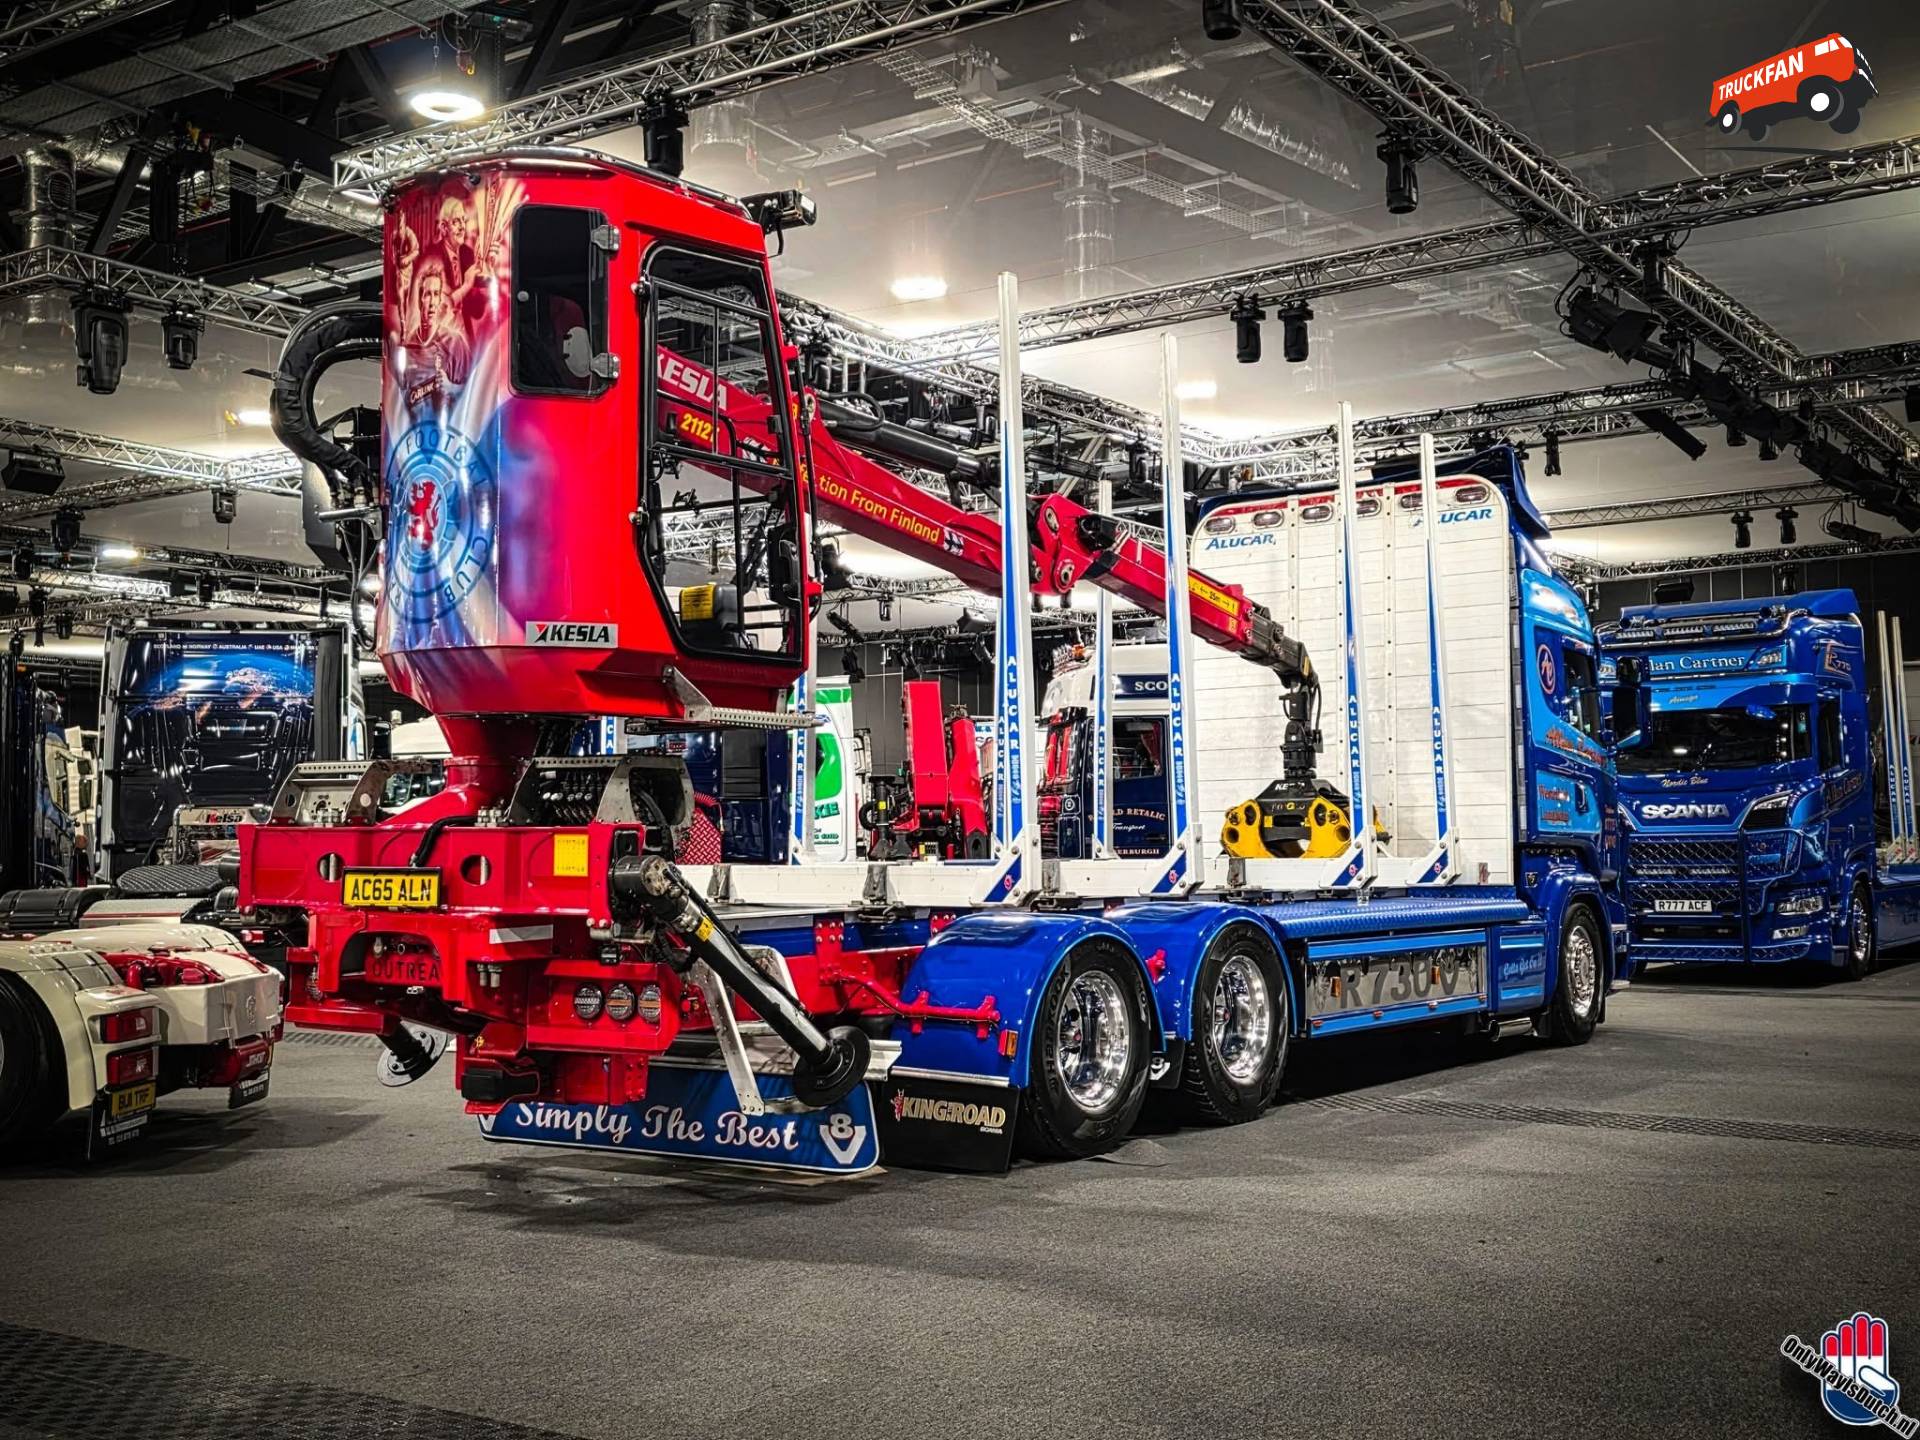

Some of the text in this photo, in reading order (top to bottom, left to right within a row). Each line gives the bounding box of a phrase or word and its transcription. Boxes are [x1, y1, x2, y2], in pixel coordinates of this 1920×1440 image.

[680, 413, 719, 442] 2112
[851, 489, 888, 519] From
[890, 508, 941, 543] Finland
[1412, 508, 1493, 527] UCAR
[1205, 534, 1274, 550] ALUCAR
[551, 624, 610, 643] KESLA
[1650, 659, 1675, 671] lan
[1679, 656, 1745, 669] Cartner
[1134, 681, 1168, 691] SCO
[1007, 655, 1020, 749] ALUCAR
[1171, 672, 1184, 757] ALUCAR
[1348, 694, 1360, 768] ALUCAR
[1432, 706, 1444, 774] ALUCAR
[997, 715, 1006, 781] ALUCAR
[1097, 725, 1106, 786] ALUCAR
[1662, 776, 1709, 788] Nordic Blue
[1126, 808, 1166, 820] RETALIC
[1641, 804, 1730, 819] SCANIA
[351, 878, 432, 902] AC65 ALN
[1658, 901, 1708, 910] R777 ACF
[371, 959, 440, 983] OUTREA
[515, 1102, 632, 1143] Simply
[641, 1105, 706, 1141] The
[713, 1111, 799, 1150] Best
